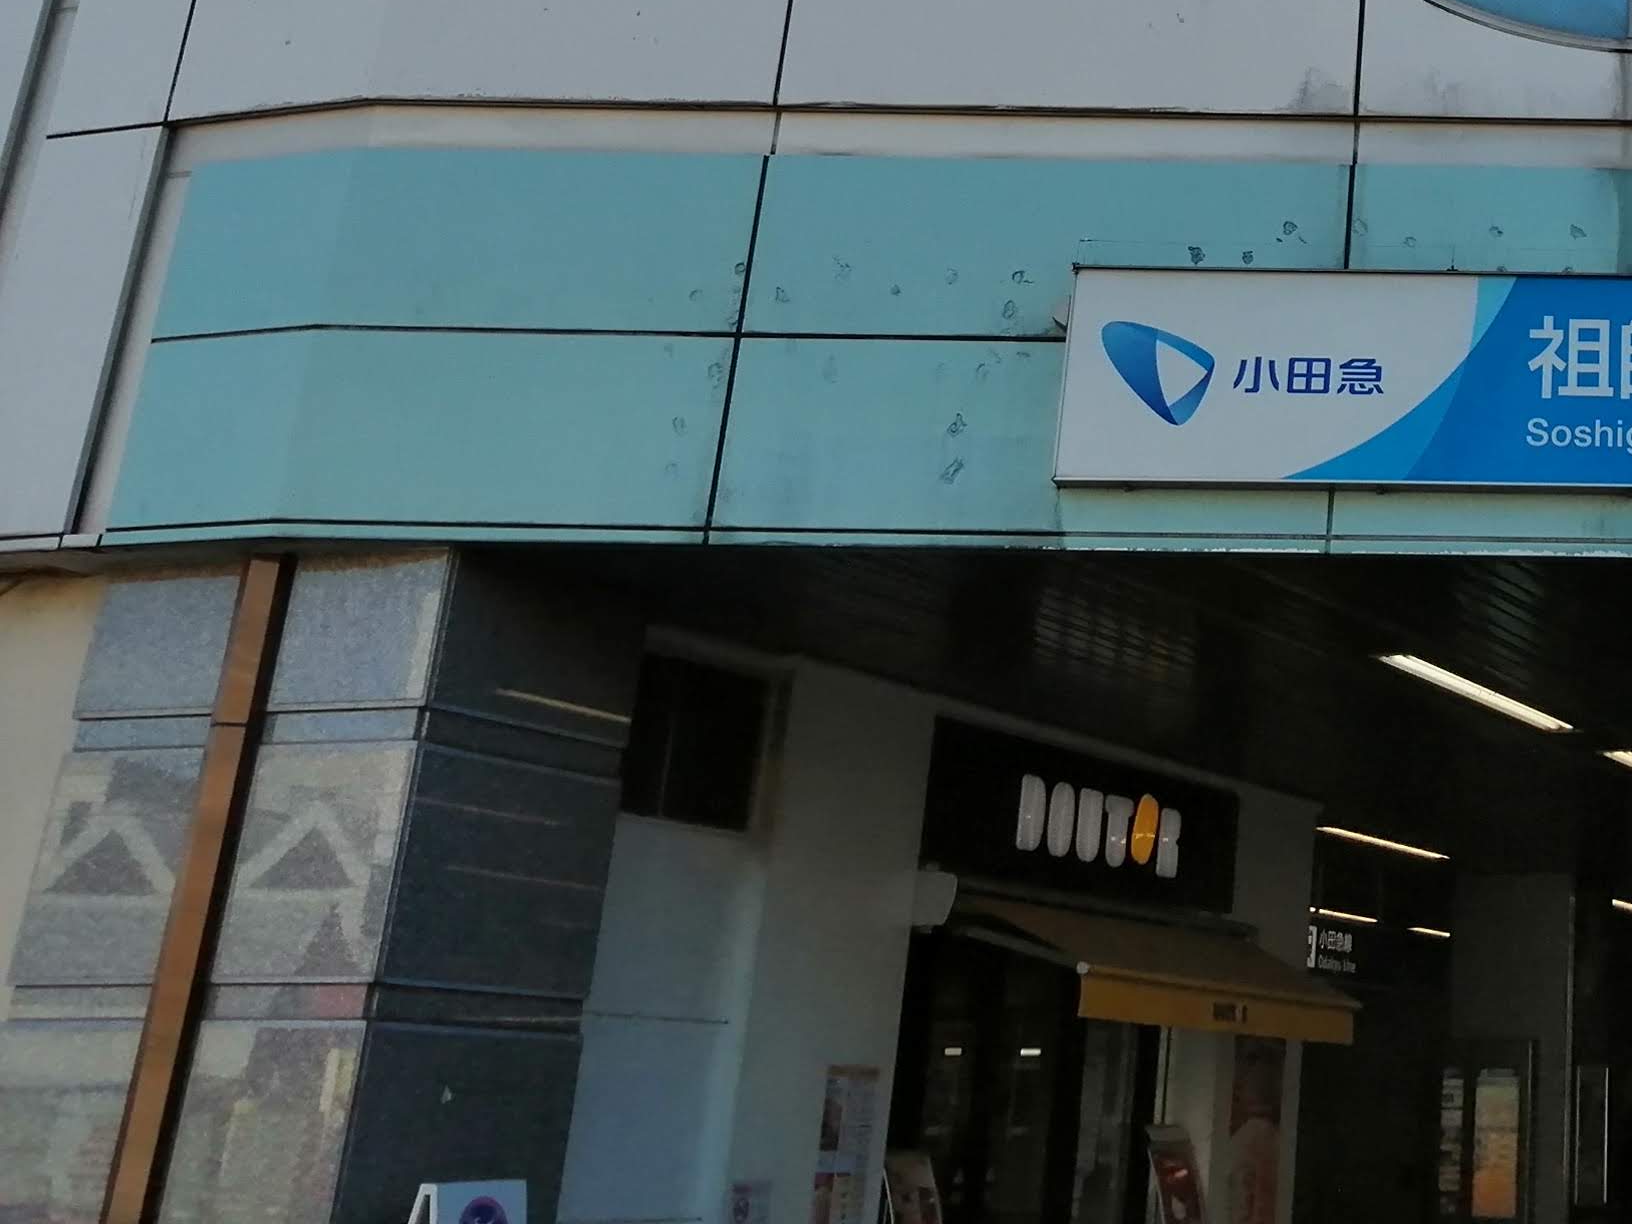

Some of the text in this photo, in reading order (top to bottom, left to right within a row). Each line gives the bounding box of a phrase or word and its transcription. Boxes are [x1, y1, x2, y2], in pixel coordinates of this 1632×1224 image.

[1233, 356, 1384, 395] 小田急
[1016, 774, 1182, 878] DOUTOR
